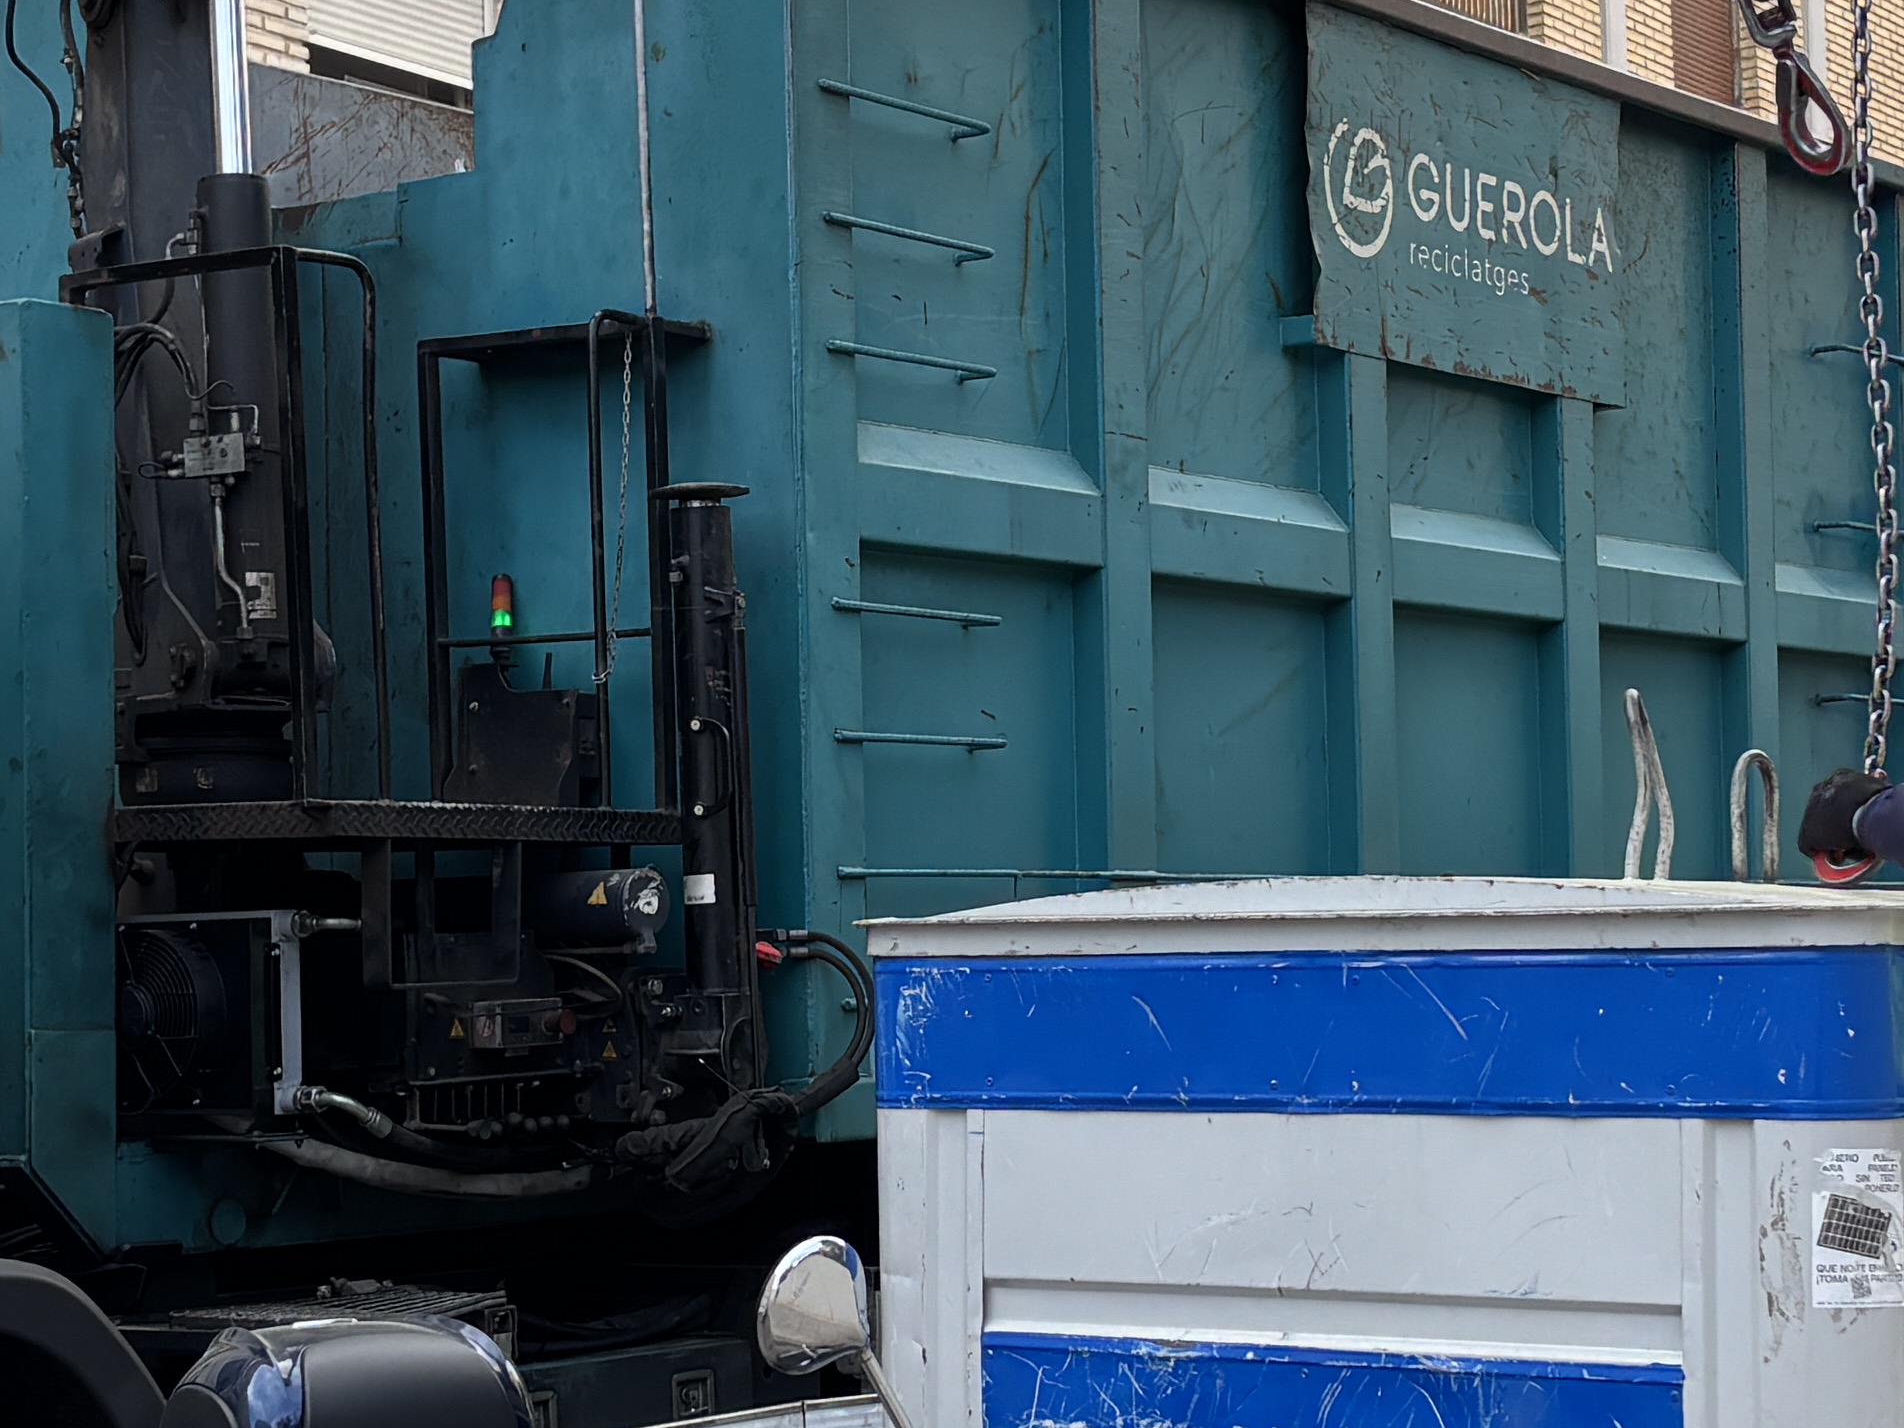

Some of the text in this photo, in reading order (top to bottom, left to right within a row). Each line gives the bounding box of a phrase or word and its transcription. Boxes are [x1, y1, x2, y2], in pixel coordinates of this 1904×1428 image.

[1408, 153, 1614, 273] GUEROLA
[1409, 241, 1530, 296] reciclatges
[1816, 1263, 1838, 1273] QUE
